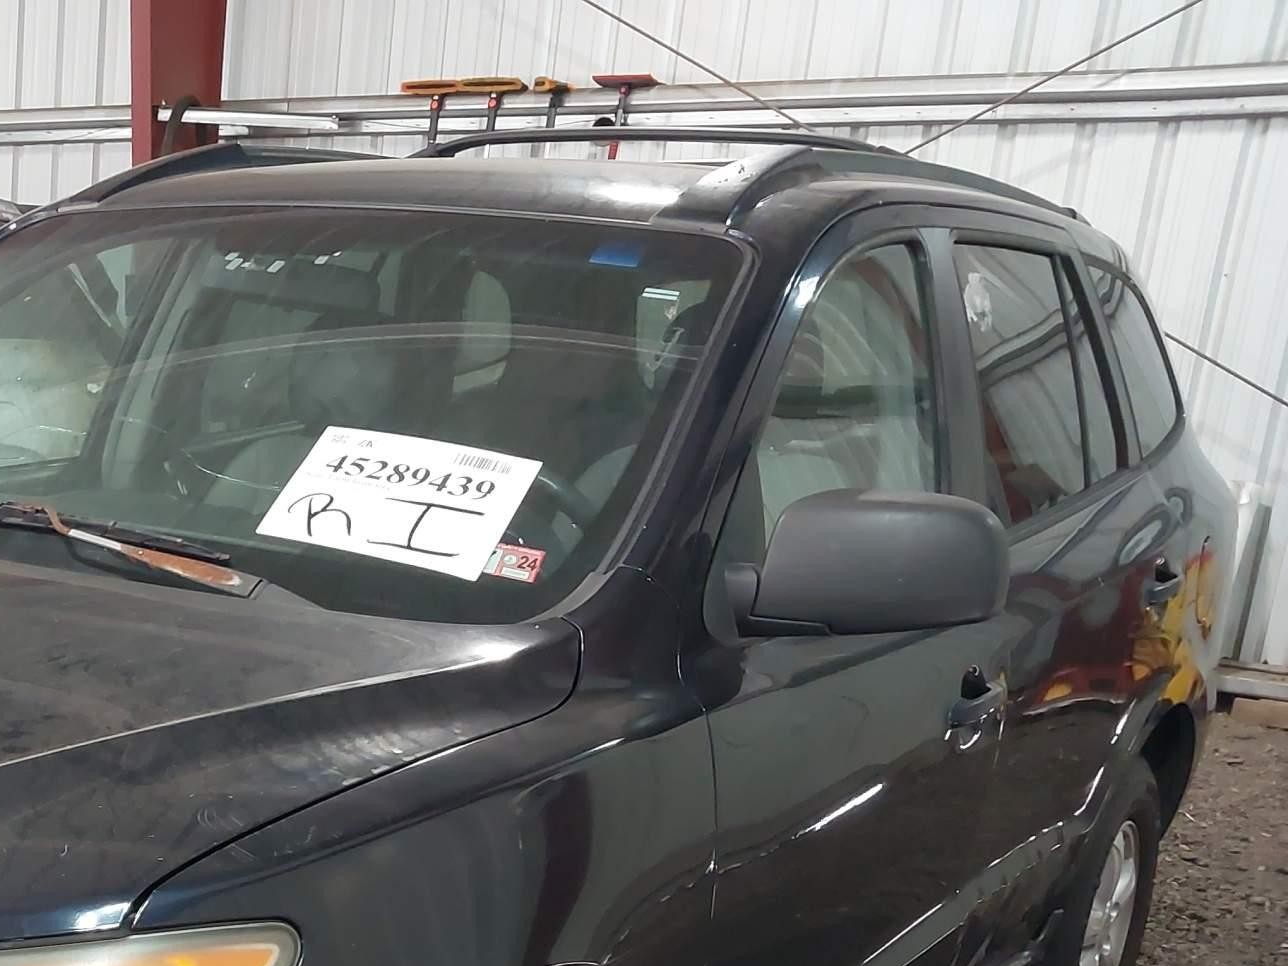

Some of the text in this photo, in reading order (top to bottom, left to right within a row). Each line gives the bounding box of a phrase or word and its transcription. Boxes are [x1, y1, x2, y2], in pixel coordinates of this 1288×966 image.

[326, 455, 496, 499] 45289439
[287, 492, 351, 536] R
[517, 555, 539, 571] 24
